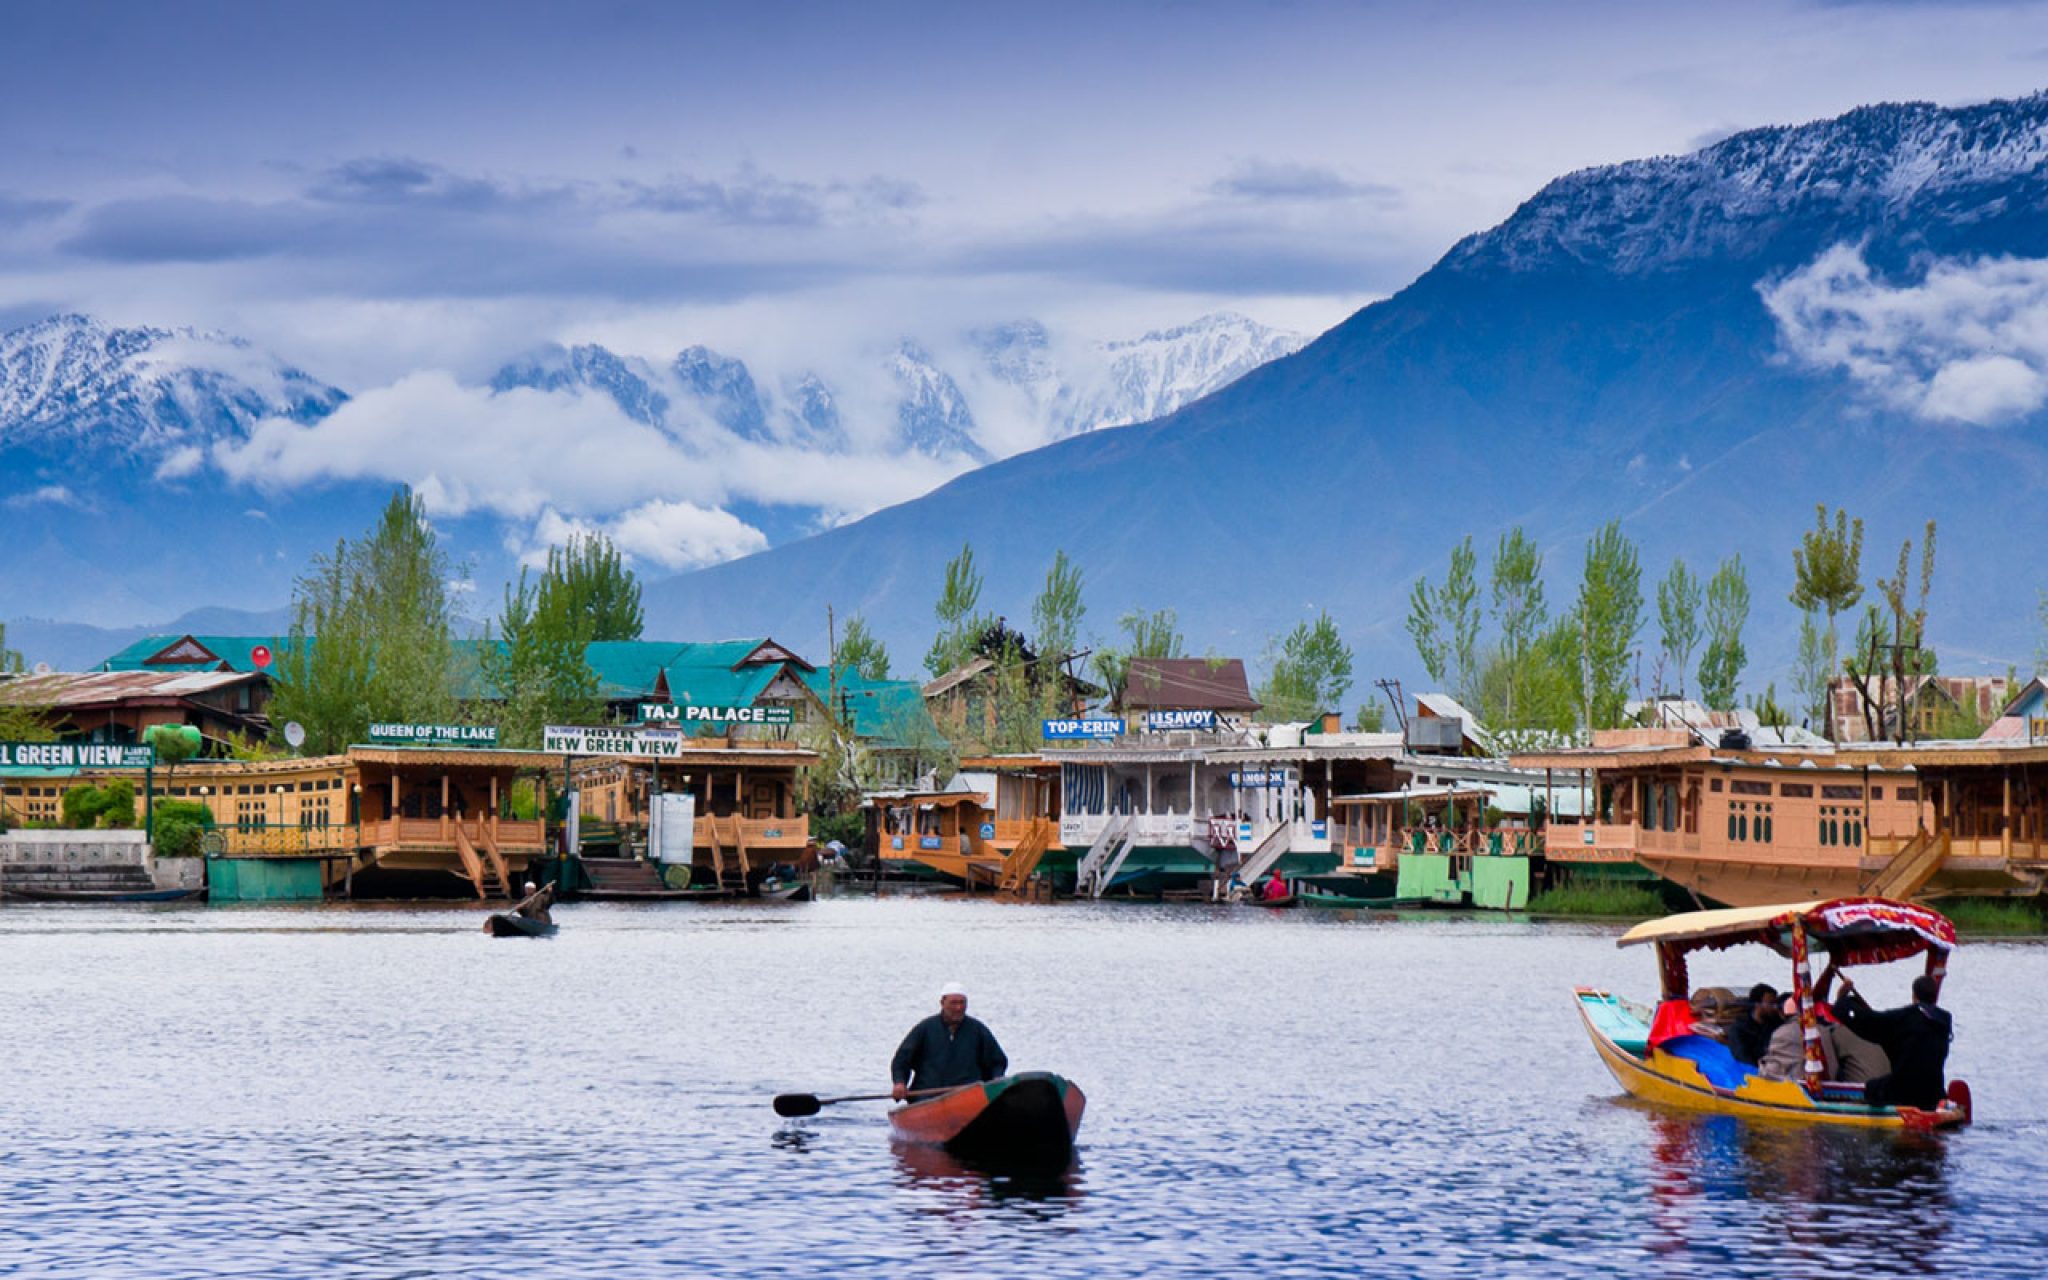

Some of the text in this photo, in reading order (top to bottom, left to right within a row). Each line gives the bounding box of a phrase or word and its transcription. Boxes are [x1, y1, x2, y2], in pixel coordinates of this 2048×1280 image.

[642, 705, 765, 721] TAJ PALACE
[371, 724, 496, 739] QUEEN OF THE LAKE
[584, 728, 638, 739] HOTEL
[547, 736, 678, 755] NEW GREEN VIEW
[0, 744, 12, 764] L
[16, 744, 73, 765] GREEN
[78, 745, 122, 766] VIEW
